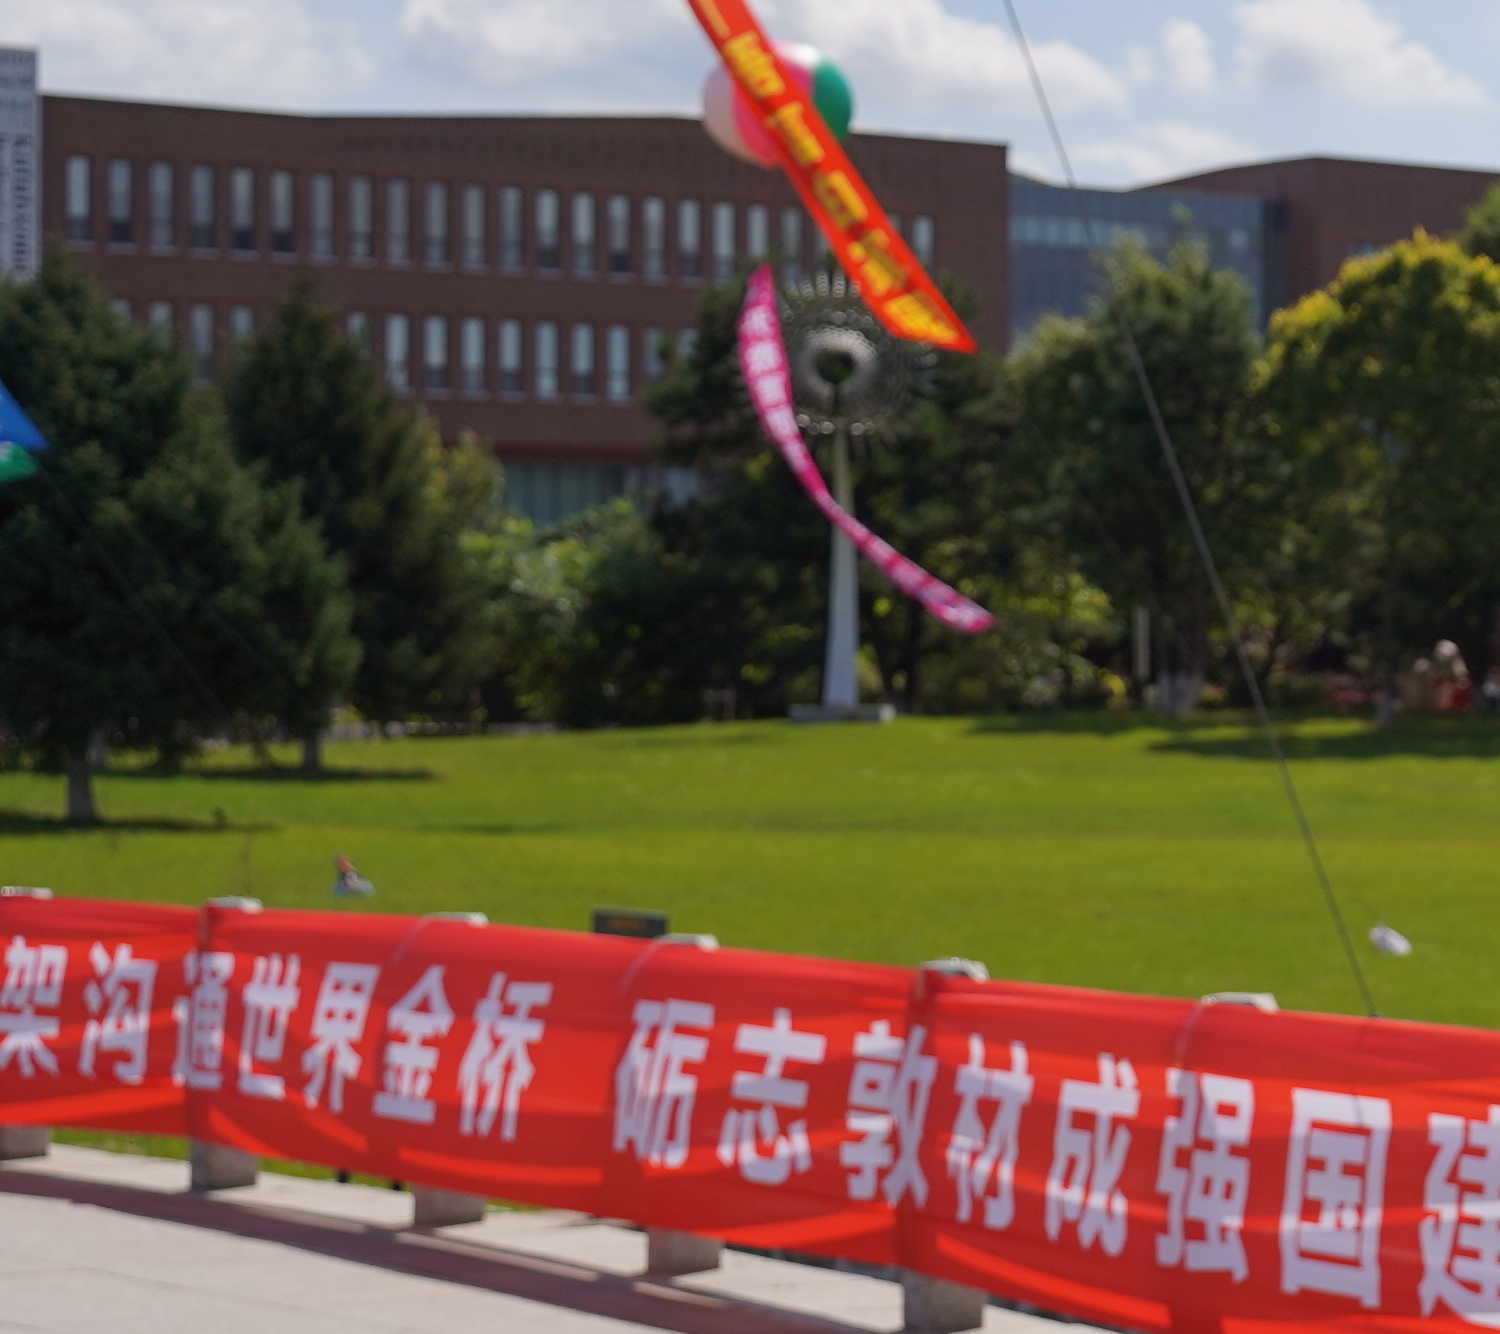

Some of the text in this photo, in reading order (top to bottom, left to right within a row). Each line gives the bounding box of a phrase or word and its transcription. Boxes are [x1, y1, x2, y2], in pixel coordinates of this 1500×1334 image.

[0, 934, 554, 1142] 架沟通世界金桥
